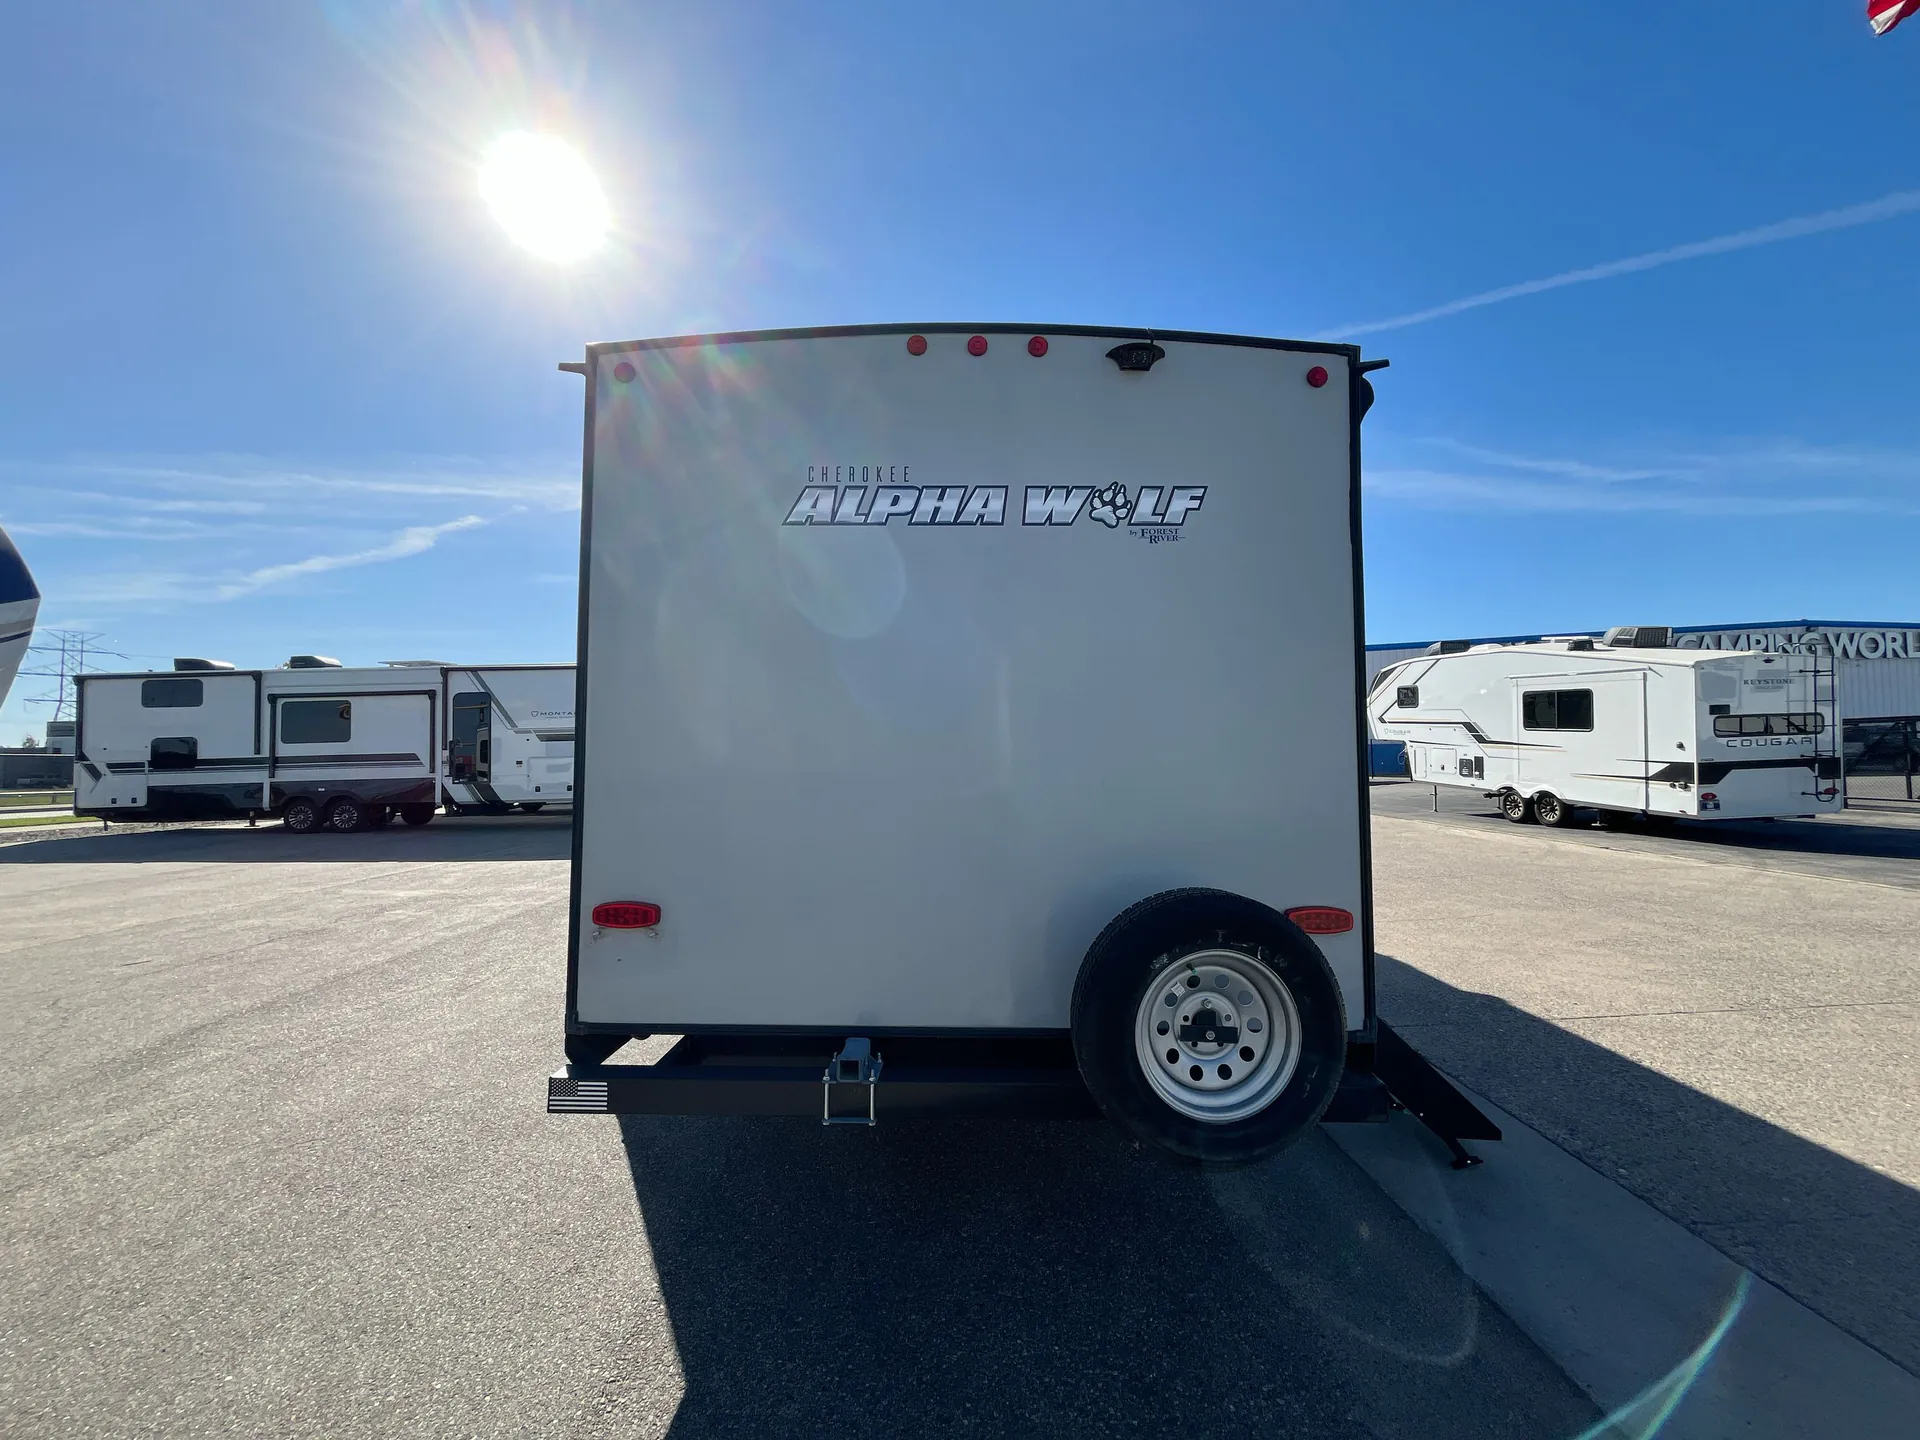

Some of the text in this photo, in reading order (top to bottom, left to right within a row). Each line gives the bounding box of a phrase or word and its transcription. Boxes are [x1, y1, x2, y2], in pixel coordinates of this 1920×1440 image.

[808, 465, 910, 483] CHEROKEE
[782, 485, 1009, 526] ALPHA
[1140, 528, 1179, 537] FOREST
[1149, 535, 1179, 544] RIVER
[1676, 631, 1920, 659] CAMPING WORL
[1726, 737, 1813, 748] COUGAR
